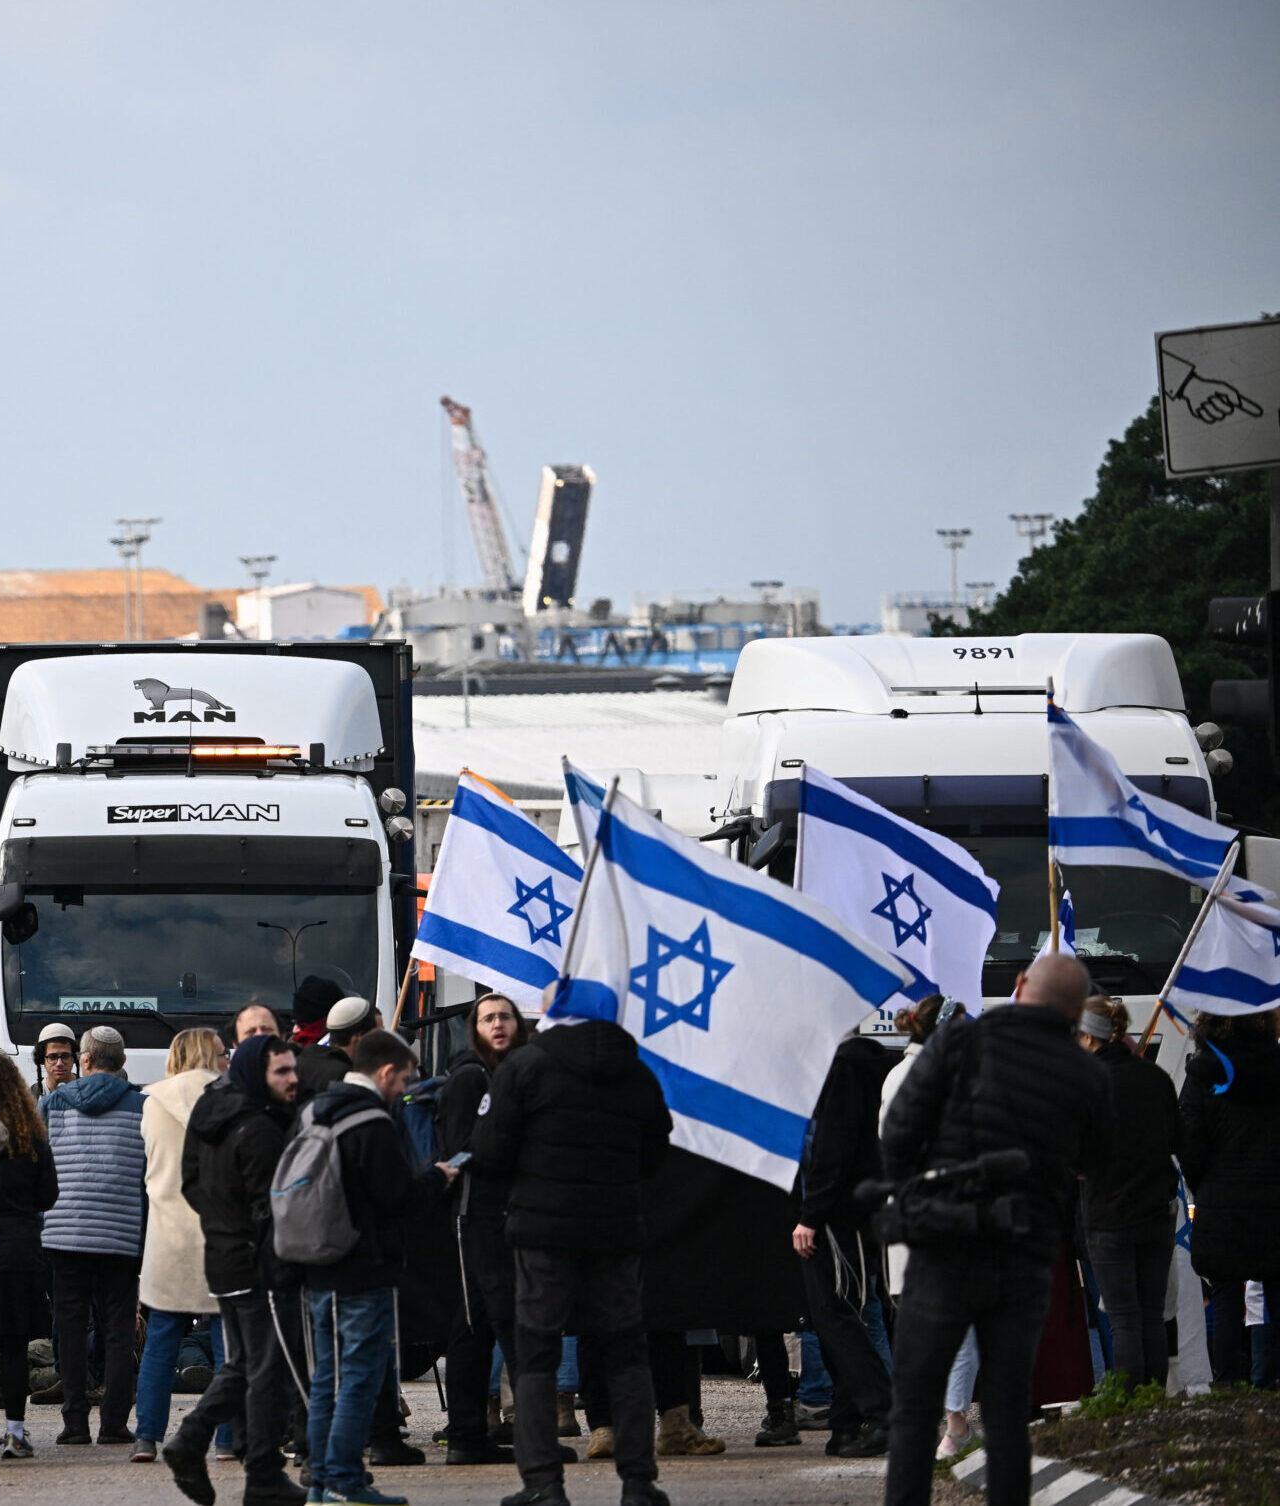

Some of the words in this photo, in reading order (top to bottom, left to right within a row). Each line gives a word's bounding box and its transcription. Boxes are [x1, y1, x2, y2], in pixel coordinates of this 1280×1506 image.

[952, 647, 1014, 660] 9891
[133, 710, 236, 724] MAN
[82, 1001, 135, 1011] MAN
